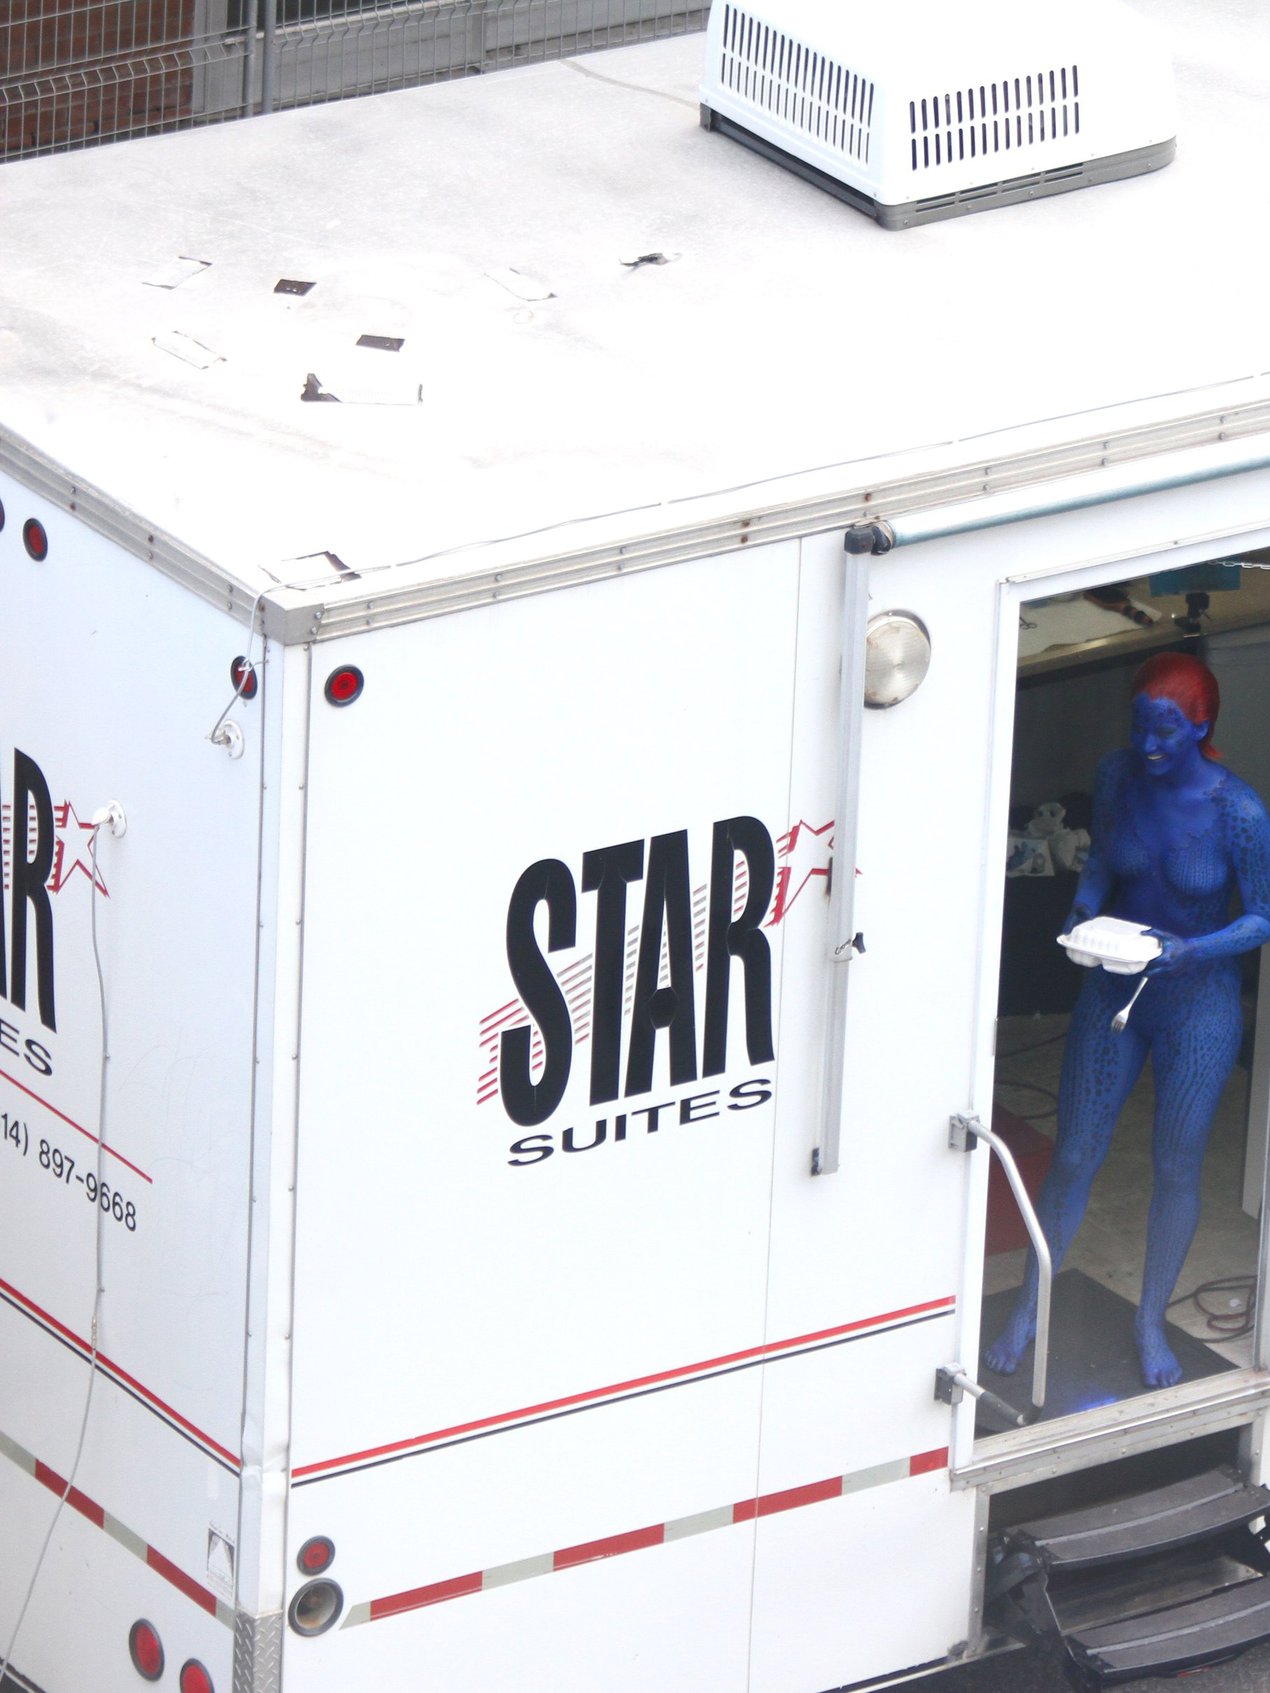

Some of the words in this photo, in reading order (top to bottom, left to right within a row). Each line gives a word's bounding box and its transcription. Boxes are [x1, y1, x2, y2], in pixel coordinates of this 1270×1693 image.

[0, 747, 57, 1034] R
[500, 815, 775, 1128] STAR
[1, 1112, 29, 1157] 14)
[39, 1138, 137, 1233] 897-9668
[507, 1078, 772, 1167] SUITES
